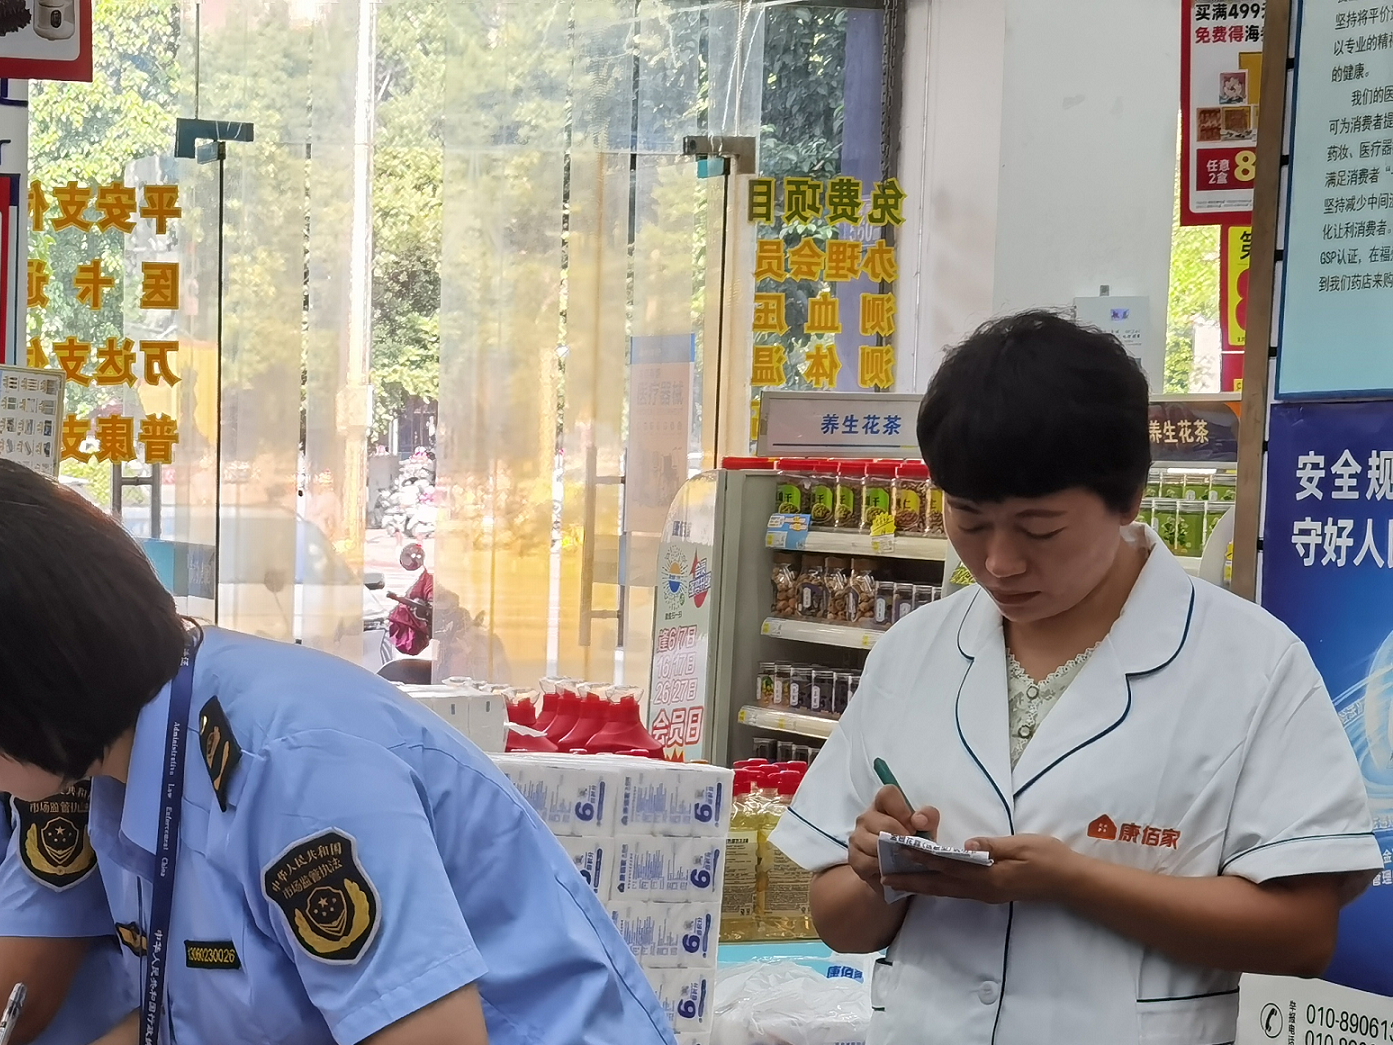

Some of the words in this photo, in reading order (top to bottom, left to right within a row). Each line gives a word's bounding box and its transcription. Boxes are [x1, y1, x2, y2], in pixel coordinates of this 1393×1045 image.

[1335, 6, 1393, 30] 坚持将平价
[1207, 159, 1230, 172] 任意
[1209, 172, 1227, 185] 2盒
[1322, 218, 1393, 240] 化让利消费者。
[1319, 244, 1393, 266] GSP认证，在福
[820, 414, 902, 436] 养生花茶
[1149, 419, 1209, 444] 养生花茶
[1291, 516, 1393, 569] 守好人
[652, 705, 704, 749] 会员日
[1118, 823, 1181, 849] 康佰家
[271, 842, 342, 892] 中华人民共和国
[282, 858, 343, 900] 市场监管执法
